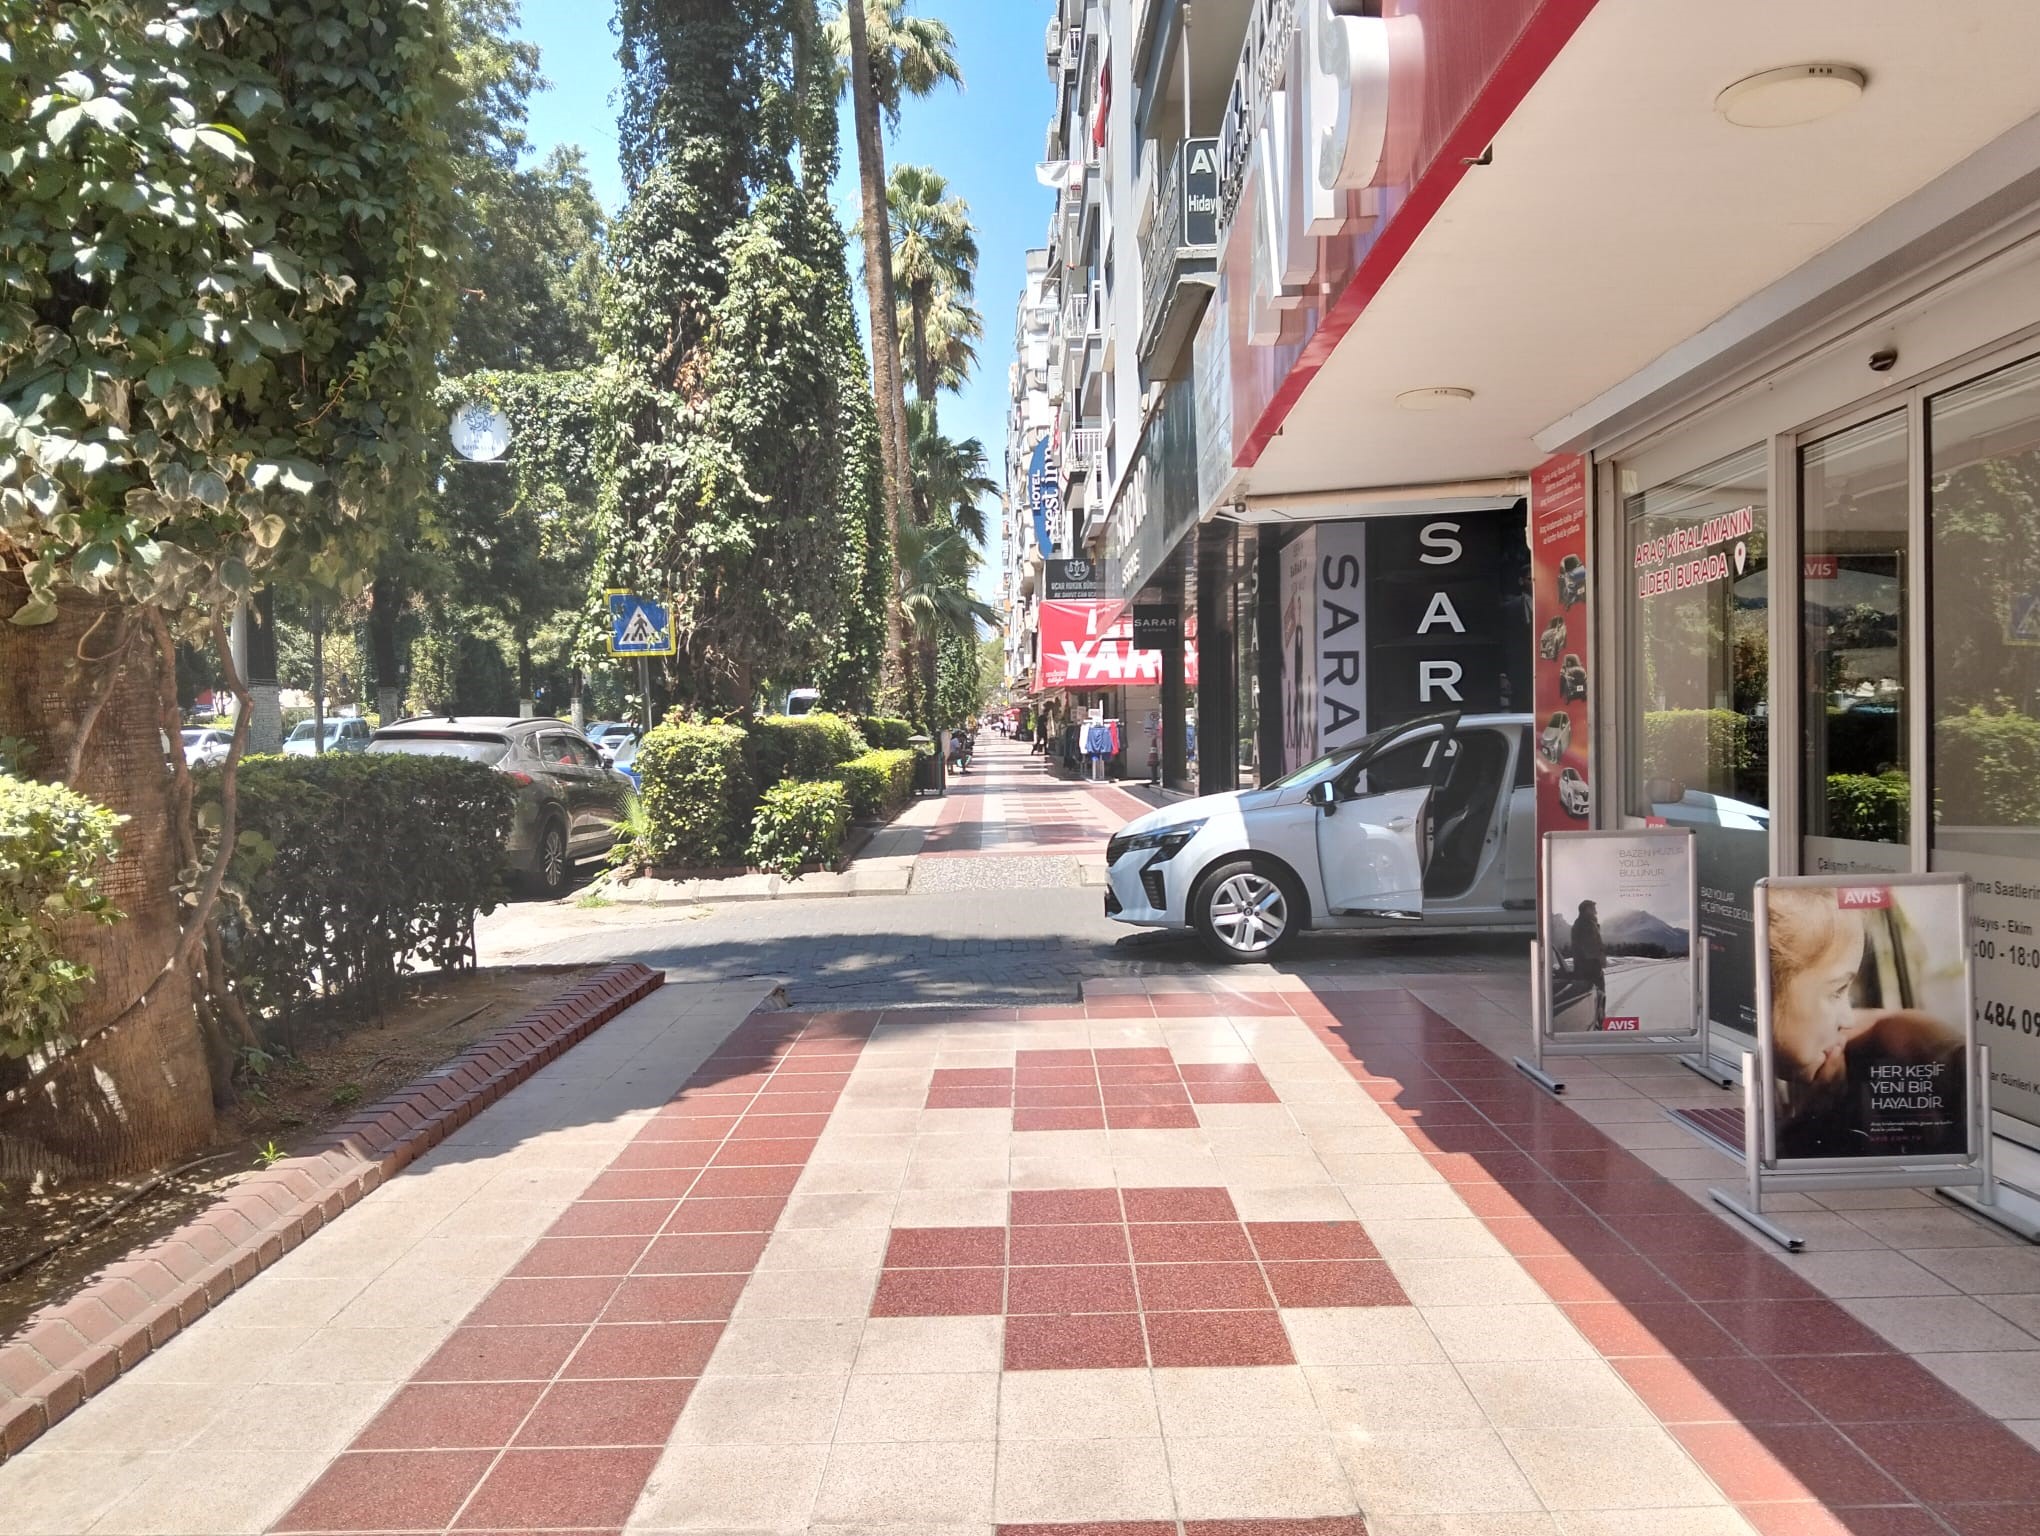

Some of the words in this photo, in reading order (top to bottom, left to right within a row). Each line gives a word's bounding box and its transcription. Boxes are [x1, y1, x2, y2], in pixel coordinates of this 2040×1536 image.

[1188, 194, 1217, 214] Hiday
[1032, 470, 1041, 510] HOTEL
[1635, 537, 1666, 567] ARAÇ
[1666, 506, 1753, 558] KİRALAMANIN
[1639, 563, 1675, 598] LİDERİ
[1675, 552, 1729, 590] BURADA
[1134, 618, 1177, 628] SARAR
[1322, 554, 1360, 754] SARA
[1619, 849, 1651, 858] BAZEN
[1619, 859, 1650, 868] YOLDA
[1619, 868, 1665, 878] BULUNUR
[1844, 890, 1882, 905] AVIS
[2007, 919, 2033, 936] Ekim
[1984, 1000, 2017, 1030] 484
[1607, 1020, 1635, 1030] AVIS
[1870, 1065, 1902, 1078] HER
[1905, 1061, 1945, 1079] KEŞİF
[1870, 1078, 1905, 1094] YENİ
[1908, 1078, 1933, 1093] BİR
[1871, 1093, 1944, 1109] HAYALDİR
